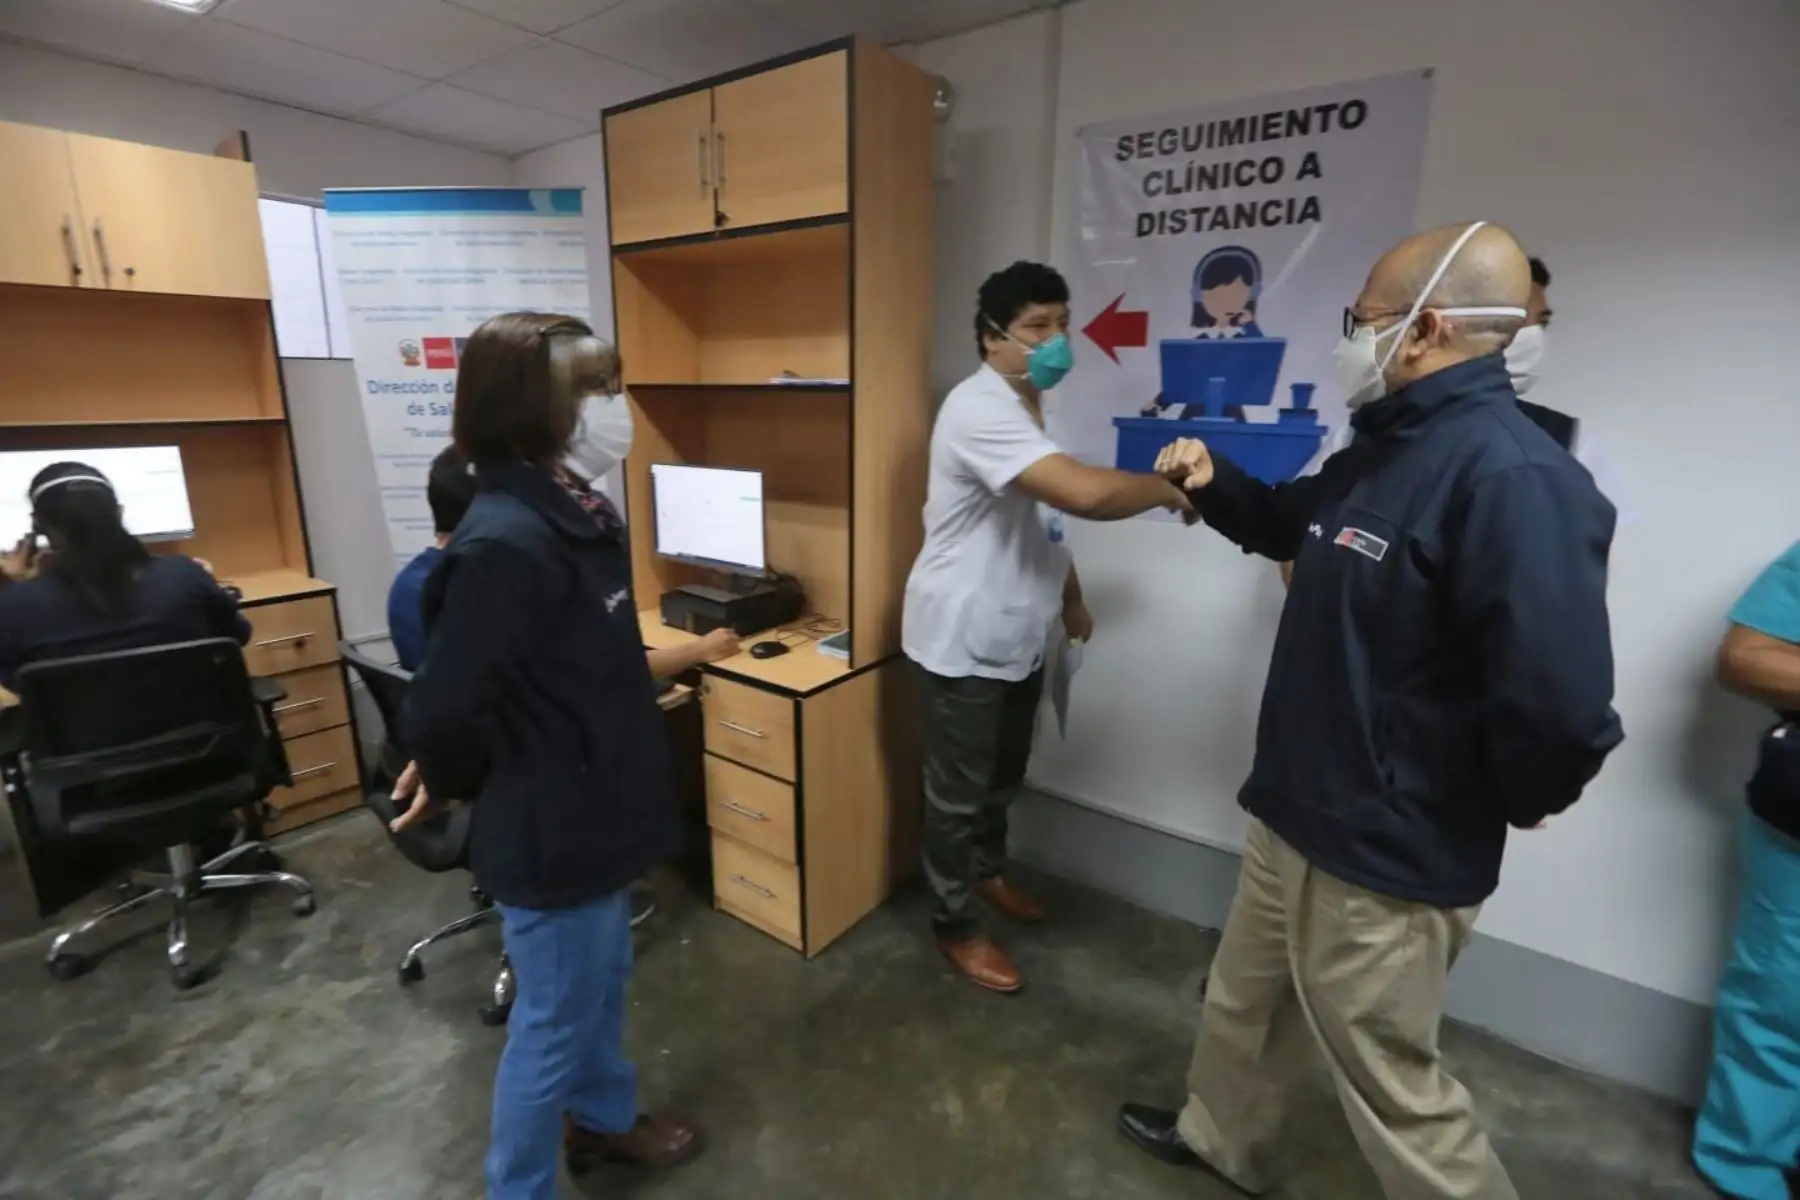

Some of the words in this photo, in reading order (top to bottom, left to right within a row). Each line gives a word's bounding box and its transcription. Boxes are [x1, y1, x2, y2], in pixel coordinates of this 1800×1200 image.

[1115, 99, 1368, 162] SEGUIMIENTO
[1142, 155, 1284, 197] CLÍNICO
[1296, 151, 1323, 181] A
[1136, 196, 1322, 238] DISTANCIA
[367, 379, 438, 394] Dirección
[443, 379, 457, 394] d
[407, 400, 425, 416] de
[428, 401, 453, 416] Sal
